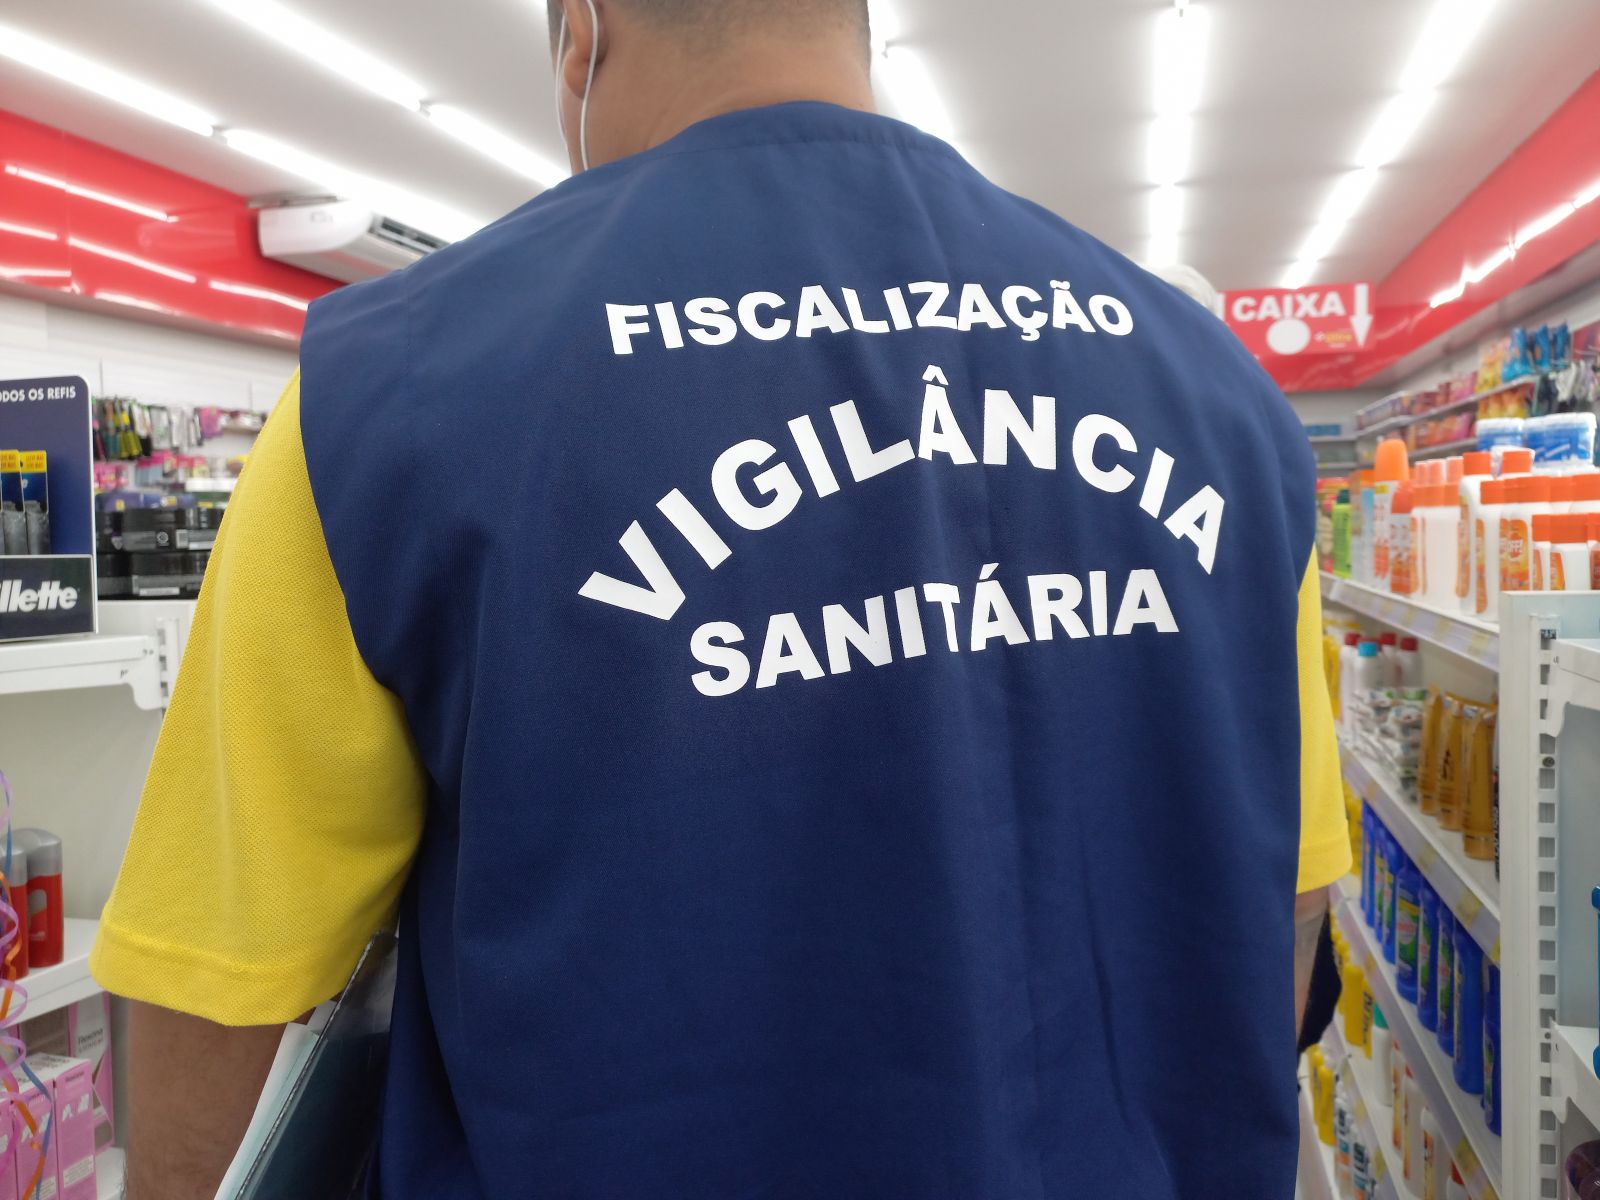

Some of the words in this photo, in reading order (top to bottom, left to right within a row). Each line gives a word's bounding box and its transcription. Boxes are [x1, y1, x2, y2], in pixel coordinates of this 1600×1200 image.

[605, 280, 1134, 355] FISCALIZAÇÃO
[1232, 291, 1346, 322] CAIXA
[0, 389, 26, 402] DOS
[28, 388, 44, 401] OS
[47, 385, 76, 400] REFIS
[577, 364, 1225, 621] VIGILÂNCIA
[0, 579, 78, 613] llette
[689, 562, 1180, 697] SANITÁRIA
